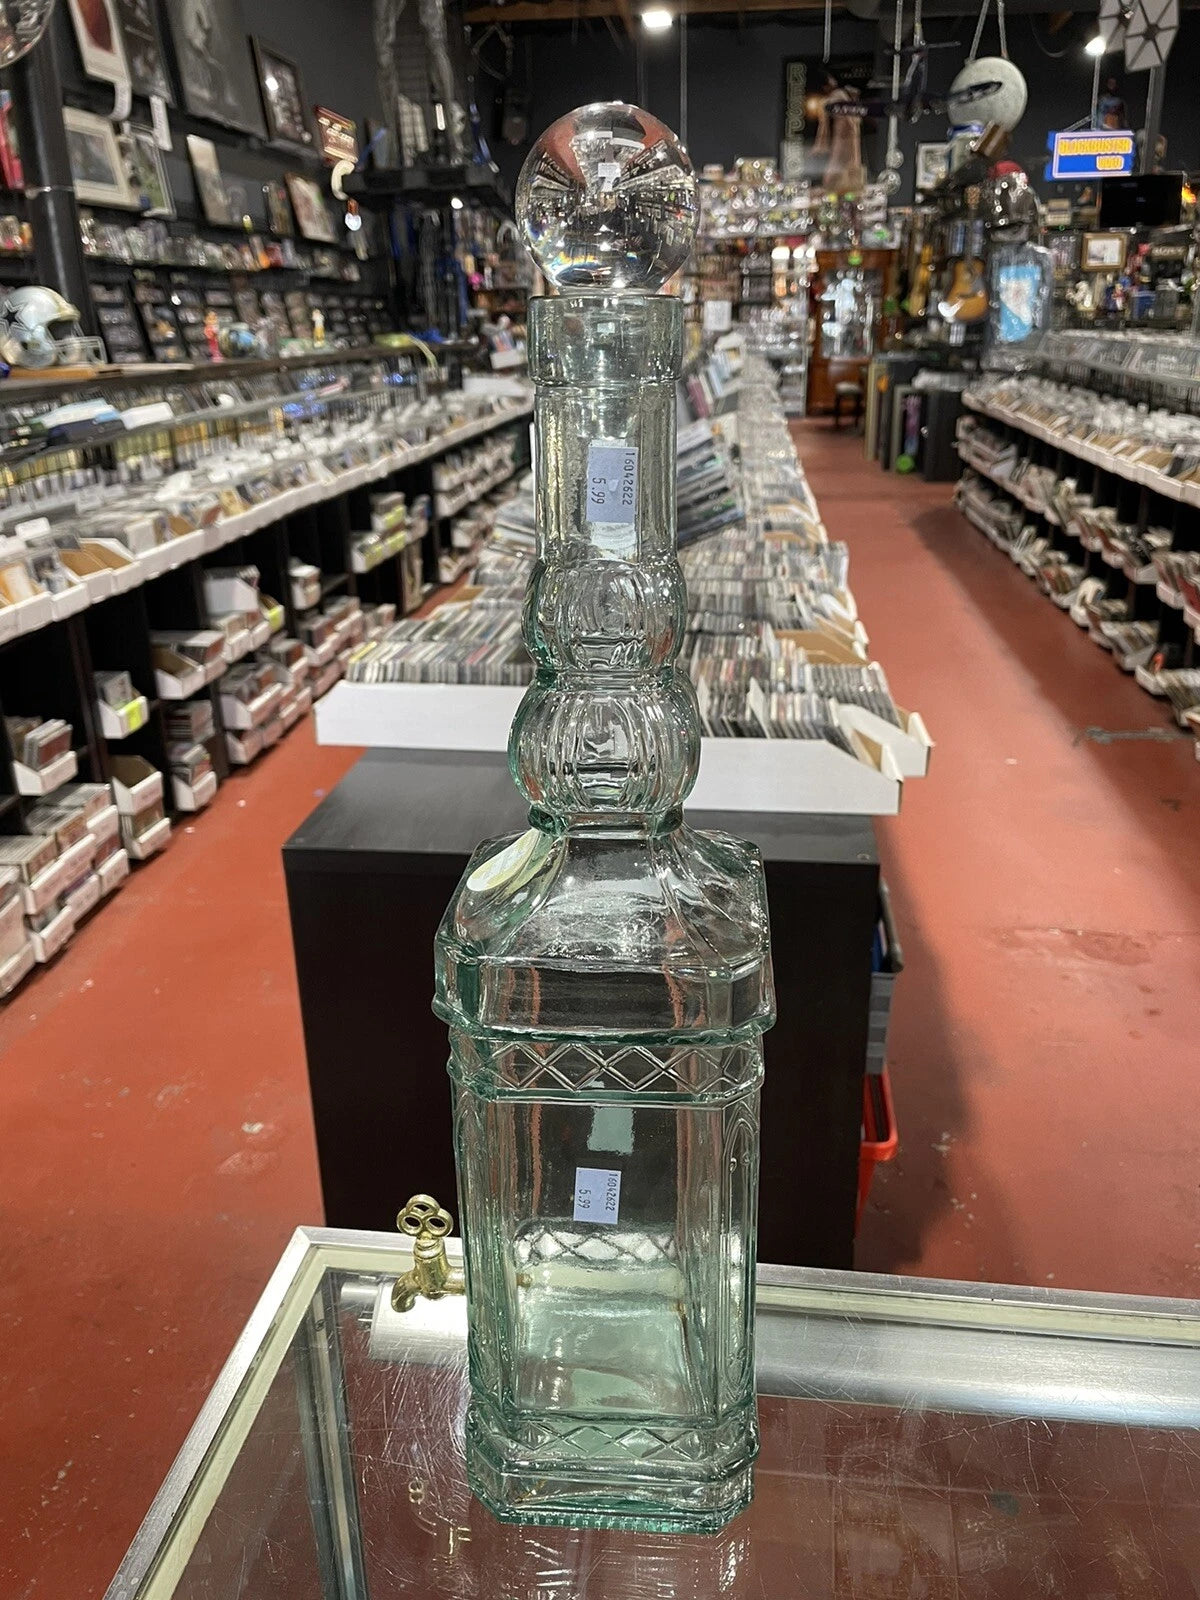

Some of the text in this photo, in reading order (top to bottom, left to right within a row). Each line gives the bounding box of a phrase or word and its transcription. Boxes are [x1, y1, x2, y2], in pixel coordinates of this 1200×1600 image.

[591, 477, 606, 504] 5.99
[622, 452, 635, 505] 16042622
[577, 1189, 591, 1209] 5.99
[605, 1173, 618, 1211] 16042622
